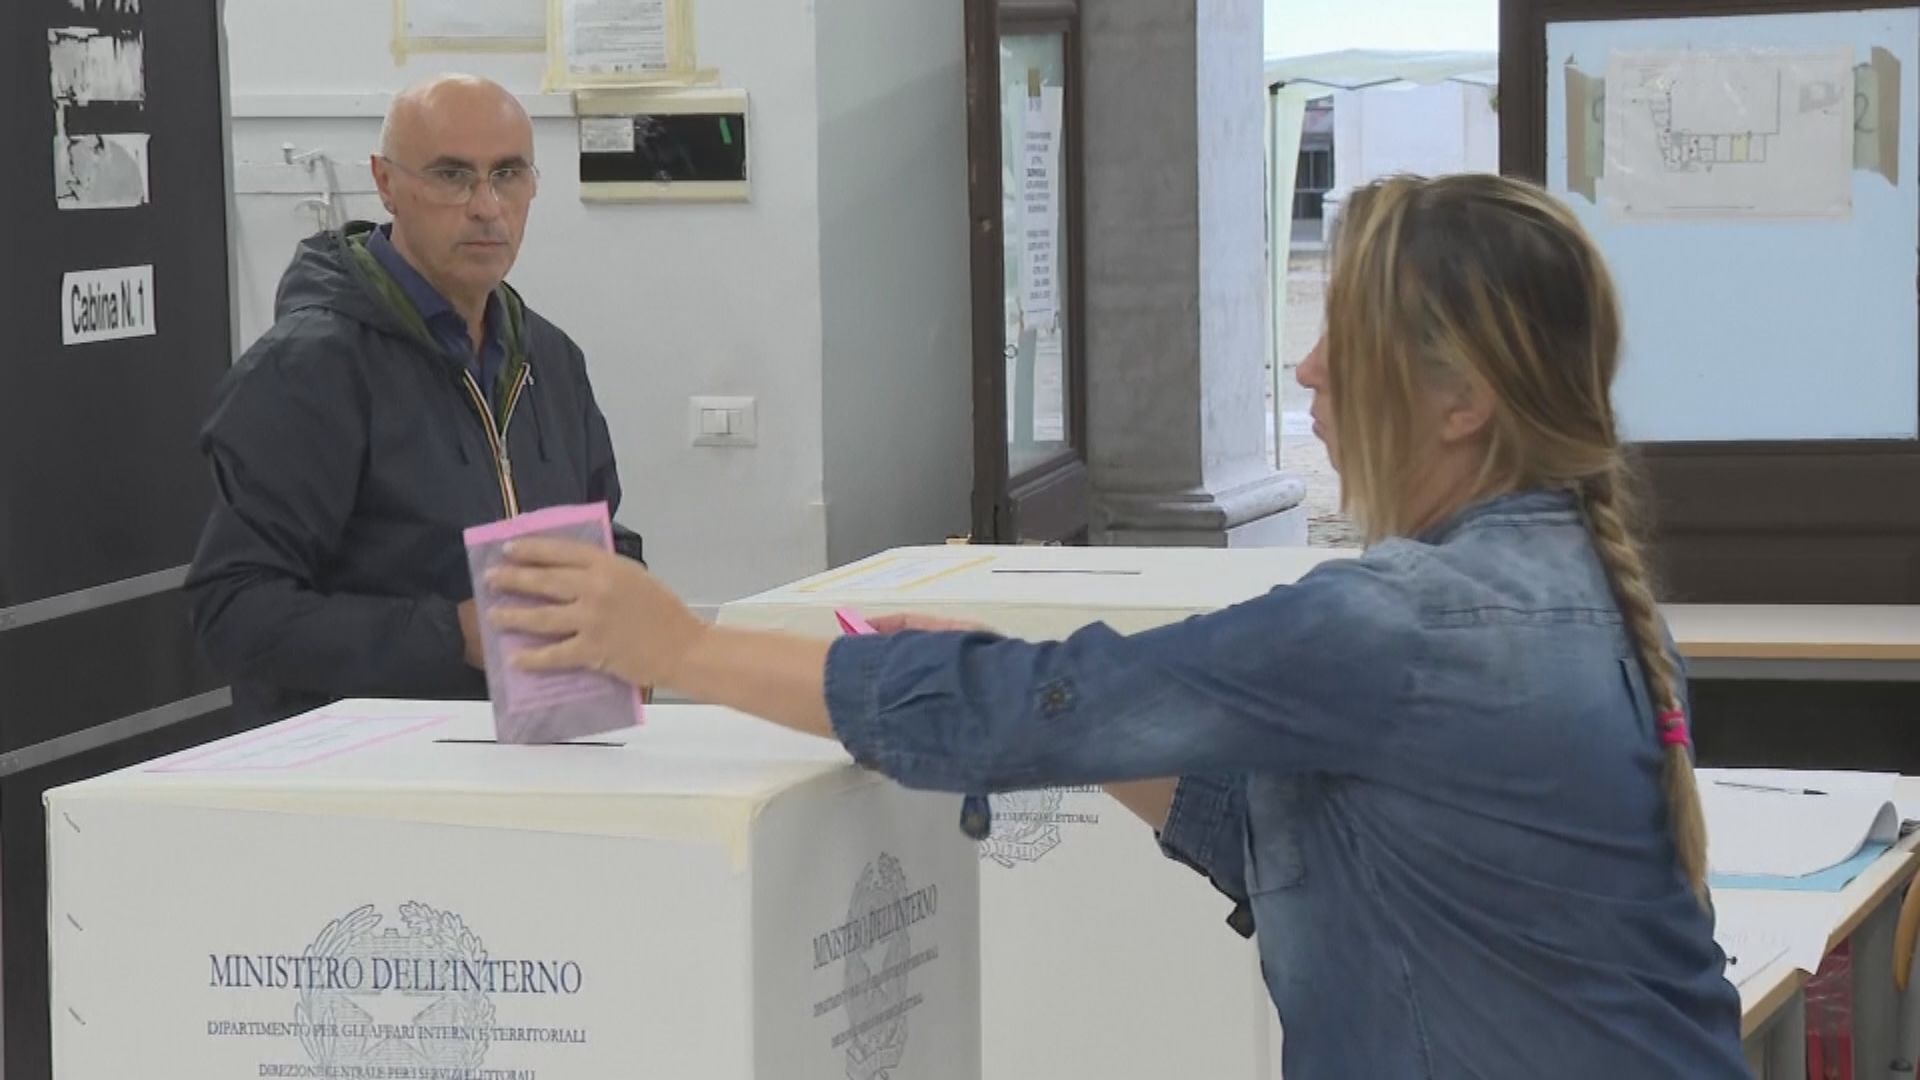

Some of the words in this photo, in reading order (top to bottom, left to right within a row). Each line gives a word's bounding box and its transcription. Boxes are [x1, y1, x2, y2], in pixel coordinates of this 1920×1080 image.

[71, 282, 118, 335] Cabina
[120, 279, 135, 328] N.
[138, 279, 145, 327] 1
[208, 953, 364, 990] MINISTERO
[371, 957, 583, 994] DELL'INTERNO
[207, 1020, 311, 1036] DIPARTIMENTO
[312, 1023, 339, 1038] PER
[341, 1023, 367, 1038] GLI
[369, 1024, 415, 1039] AFFARI
[418, 1024, 475, 1040] INTERNI
[491, 1027, 587, 1043] TERRITORIALI
